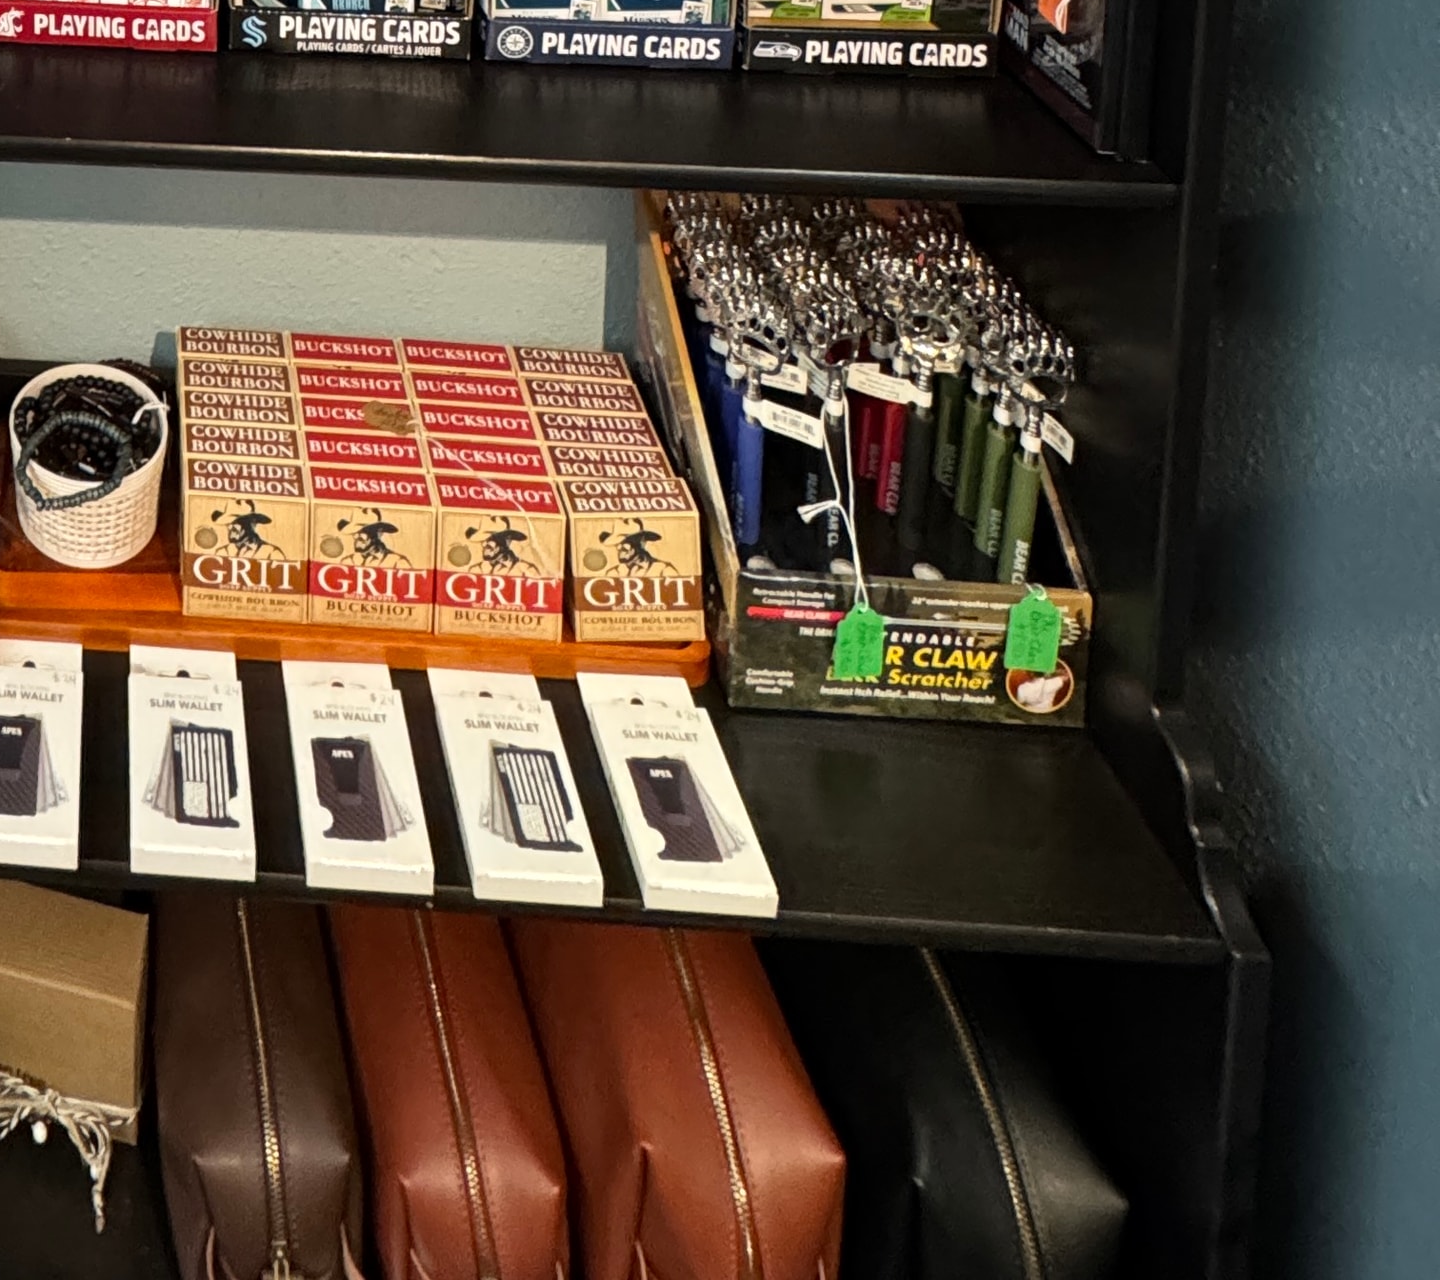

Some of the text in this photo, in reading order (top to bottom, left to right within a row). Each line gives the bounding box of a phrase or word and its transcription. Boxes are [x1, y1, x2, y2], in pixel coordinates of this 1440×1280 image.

[33, 13, 206, 42] PLAYING CARDS
[279, 15, 461, 45] PLAYING CARDS
[297, 41, 334, 53] PLAYING
[335, 43, 364, 54] CARDS
[371, 43, 404, 55] CARTES
[413, 45, 442, 56] JOUER
[541, 32, 638, 57] PLAYING
[643, 35, 721, 61] CARDS
[804, 40, 988, 68] PLAYING CARDS
[185, 328, 279, 344] COWHIDE
[185, 340, 280, 357] BOURBON
[294, 340, 394, 358] BUCKSHOT
[406, 345, 508, 365] BUCKSHOT
[519, 348, 617, 366] COWHIDE
[523, 360, 623, 378] BOURBON
[300, 374, 403, 391] BUCKSHOT
[193, 461, 298, 480] COWHIDE
[888, 461, 901, 490] BEAR
[193, 476, 300, 496] BOURBON
[314, 476, 426, 497] BUCKSHOT
[440, 483, 553, 505] BUCKSHOT
[569, 478, 680, 496] COWHIDE
[575, 495, 687, 513] BOURBON
[988, 508, 1002, 539] BEAR
[1016, 540, 1030, 569] BEAR
[192, 554, 301, 591] GRIT
[317, 562, 427, 600] GRIT
[445, 572, 560, 609] GRIT
[583, 576, 696, 608] GRIT
[191, 592, 301, 608] COWHIDE BOURBON
[325, 599, 417, 617] BUCKSHOT
[454, 610, 545, 627] BUCKSHOT
[583, 615, 640, 626] COWHIDE
[913, 647, 998, 672] CLAW
[887, 669, 994, 690] Scratcher
[21, 690, 64, 703] WALLET
[149, 697, 223, 712] SLIM WALLET
[312, 710, 388, 724] SLIM WALLET
[0, 726, 23, 737] APEX
[622, 729, 699, 743] SLIM WALLET
[331, 748, 356, 760] APEX
[649, 767, 673, 780] APEX
